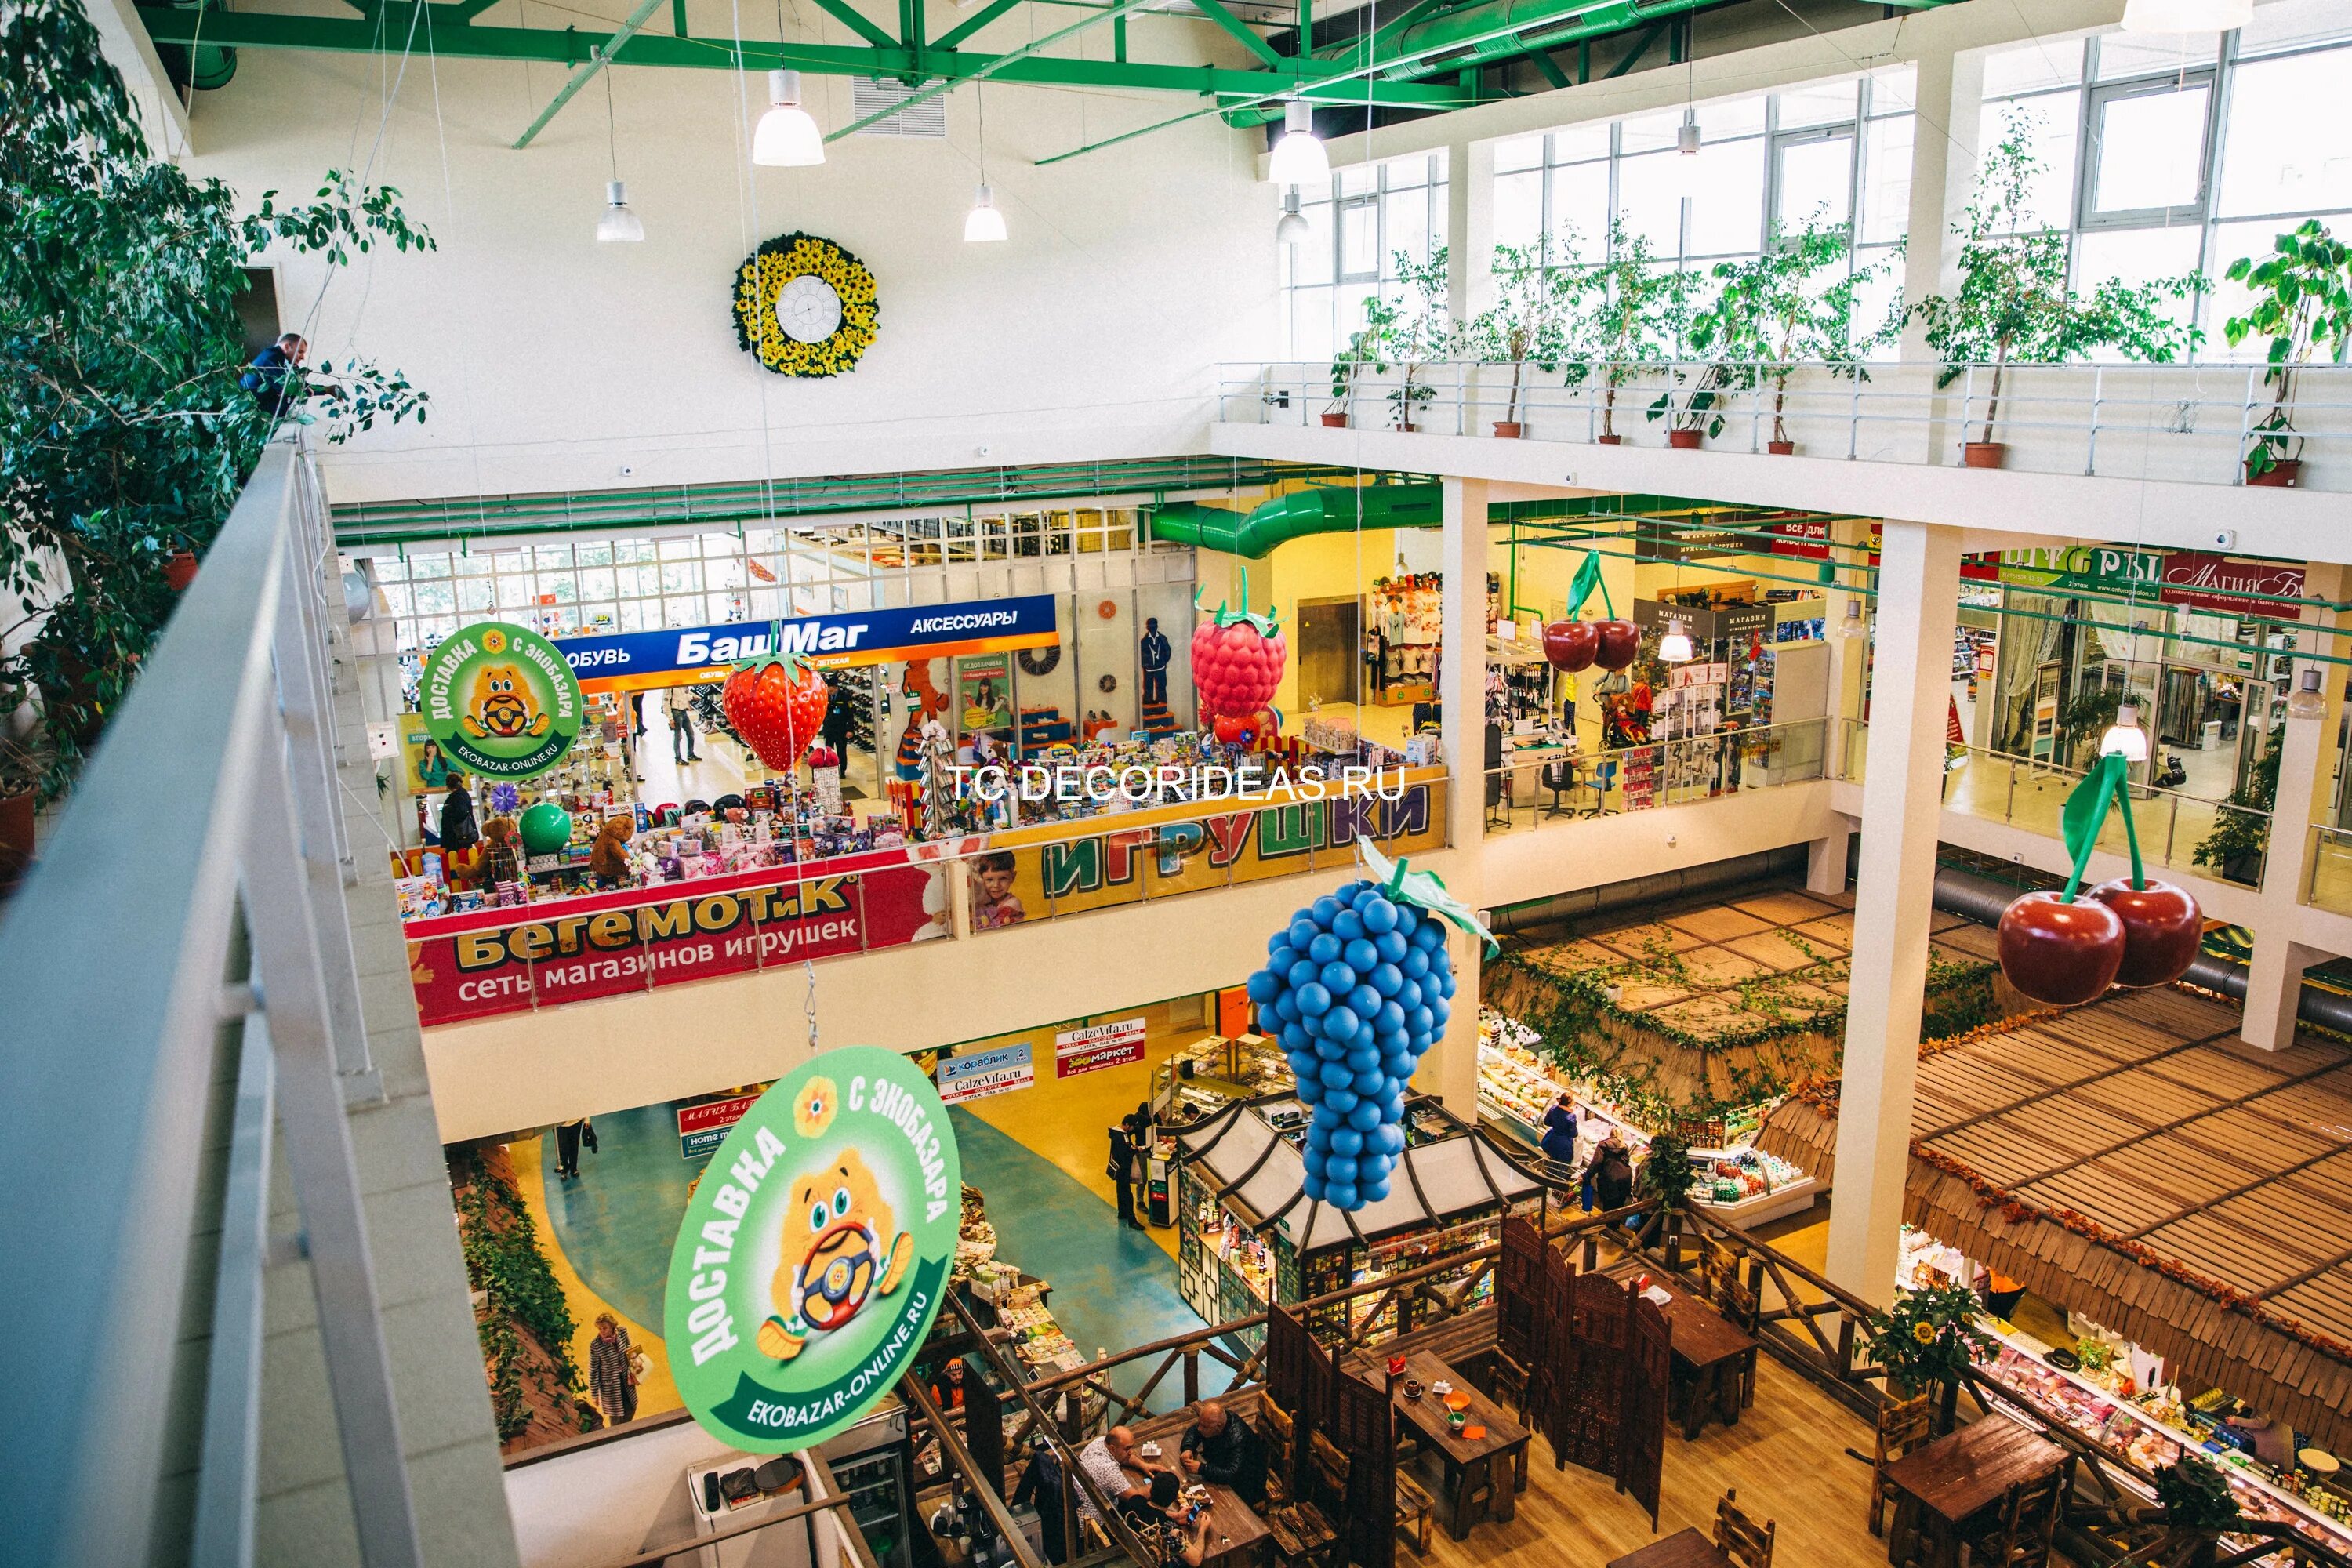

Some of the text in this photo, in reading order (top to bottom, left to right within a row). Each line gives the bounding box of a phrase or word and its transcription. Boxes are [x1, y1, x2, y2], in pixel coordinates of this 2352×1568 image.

[1807, 524, 1825, 536] для
[910, 610, 1018, 633] АКСЕССУАРЫ
[1658, 609, 1693, 622] МАГАЗИН
[1729, 614, 1766, 625] МАГАЗИН
[677, 622, 869, 666] БашМаг
[567, 648, 630, 669] ОБУВЬ
[430, 637, 572, 720] ДОСТАВКА С ЭКОБАЗАРА
[458, 744, 558, 771] EKOBAZAR-ONLINE.RU
[1044, 785, 1430, 899] ИГРУШКИ
[459, 916, 857, 1003] сеть магазинов игрушек
[1072, 1022, 1133, 1041] CalzeVita.ru
[955, 1070, 1021, 1091] CalzeVita.ru
[974, 1083, 1002, 1094] КОЛГОТКИ
[684, 1105, 727, 1122] МАГИЯ
[688, 1076, 948, 1366] ДОСТАВКА С ЭКОБАЗАРА
[747, 1291, 927, 1428] EKOBAZAR-ONLINE.RU
